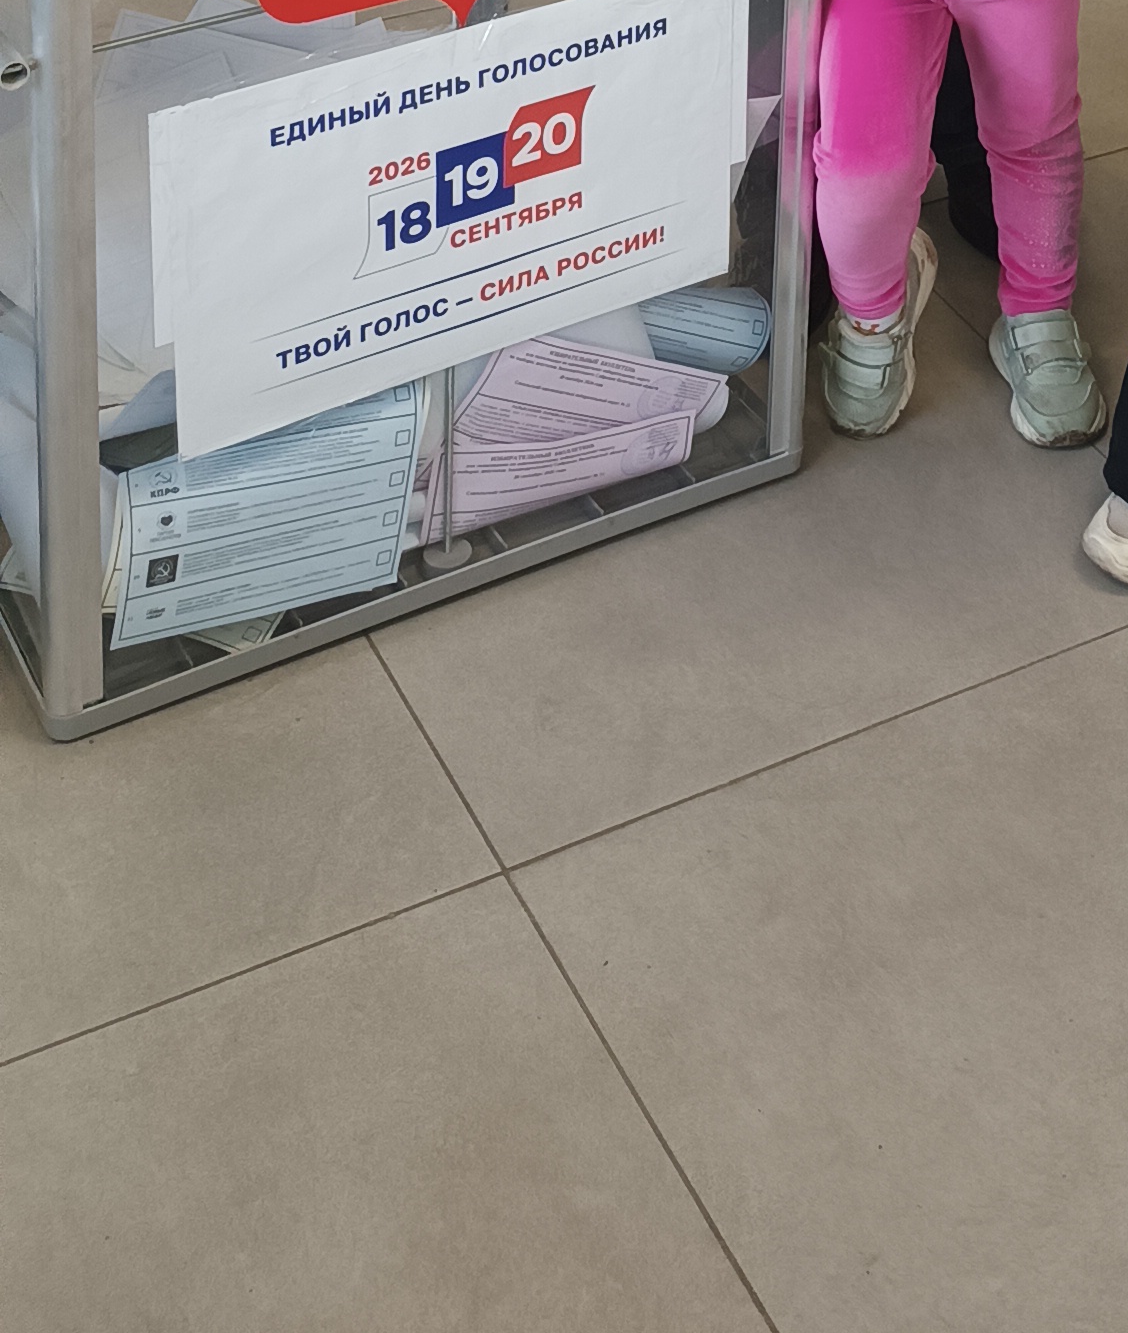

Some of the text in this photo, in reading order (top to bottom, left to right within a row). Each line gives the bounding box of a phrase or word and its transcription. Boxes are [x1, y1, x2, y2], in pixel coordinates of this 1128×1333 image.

[270, 18, 667, 147] ЕДИНЫЙ ДЕНЬ ГОЛОСОВАНИЯ
[368, 152, 431, 186] 2026
[377, 112, 576, 251] 18 19 20
[450, 191, 583, 248] СЕНТЯБРЯ
[276, 325, 351, 369] ТВОЙ
[360, 298, 449, 342] ГОЛОС
[480, 265, 549, 301] СИЛА
[557, 226, 665, 277] РОССИИ!
[150, 487, 180, 498] КПРФ
